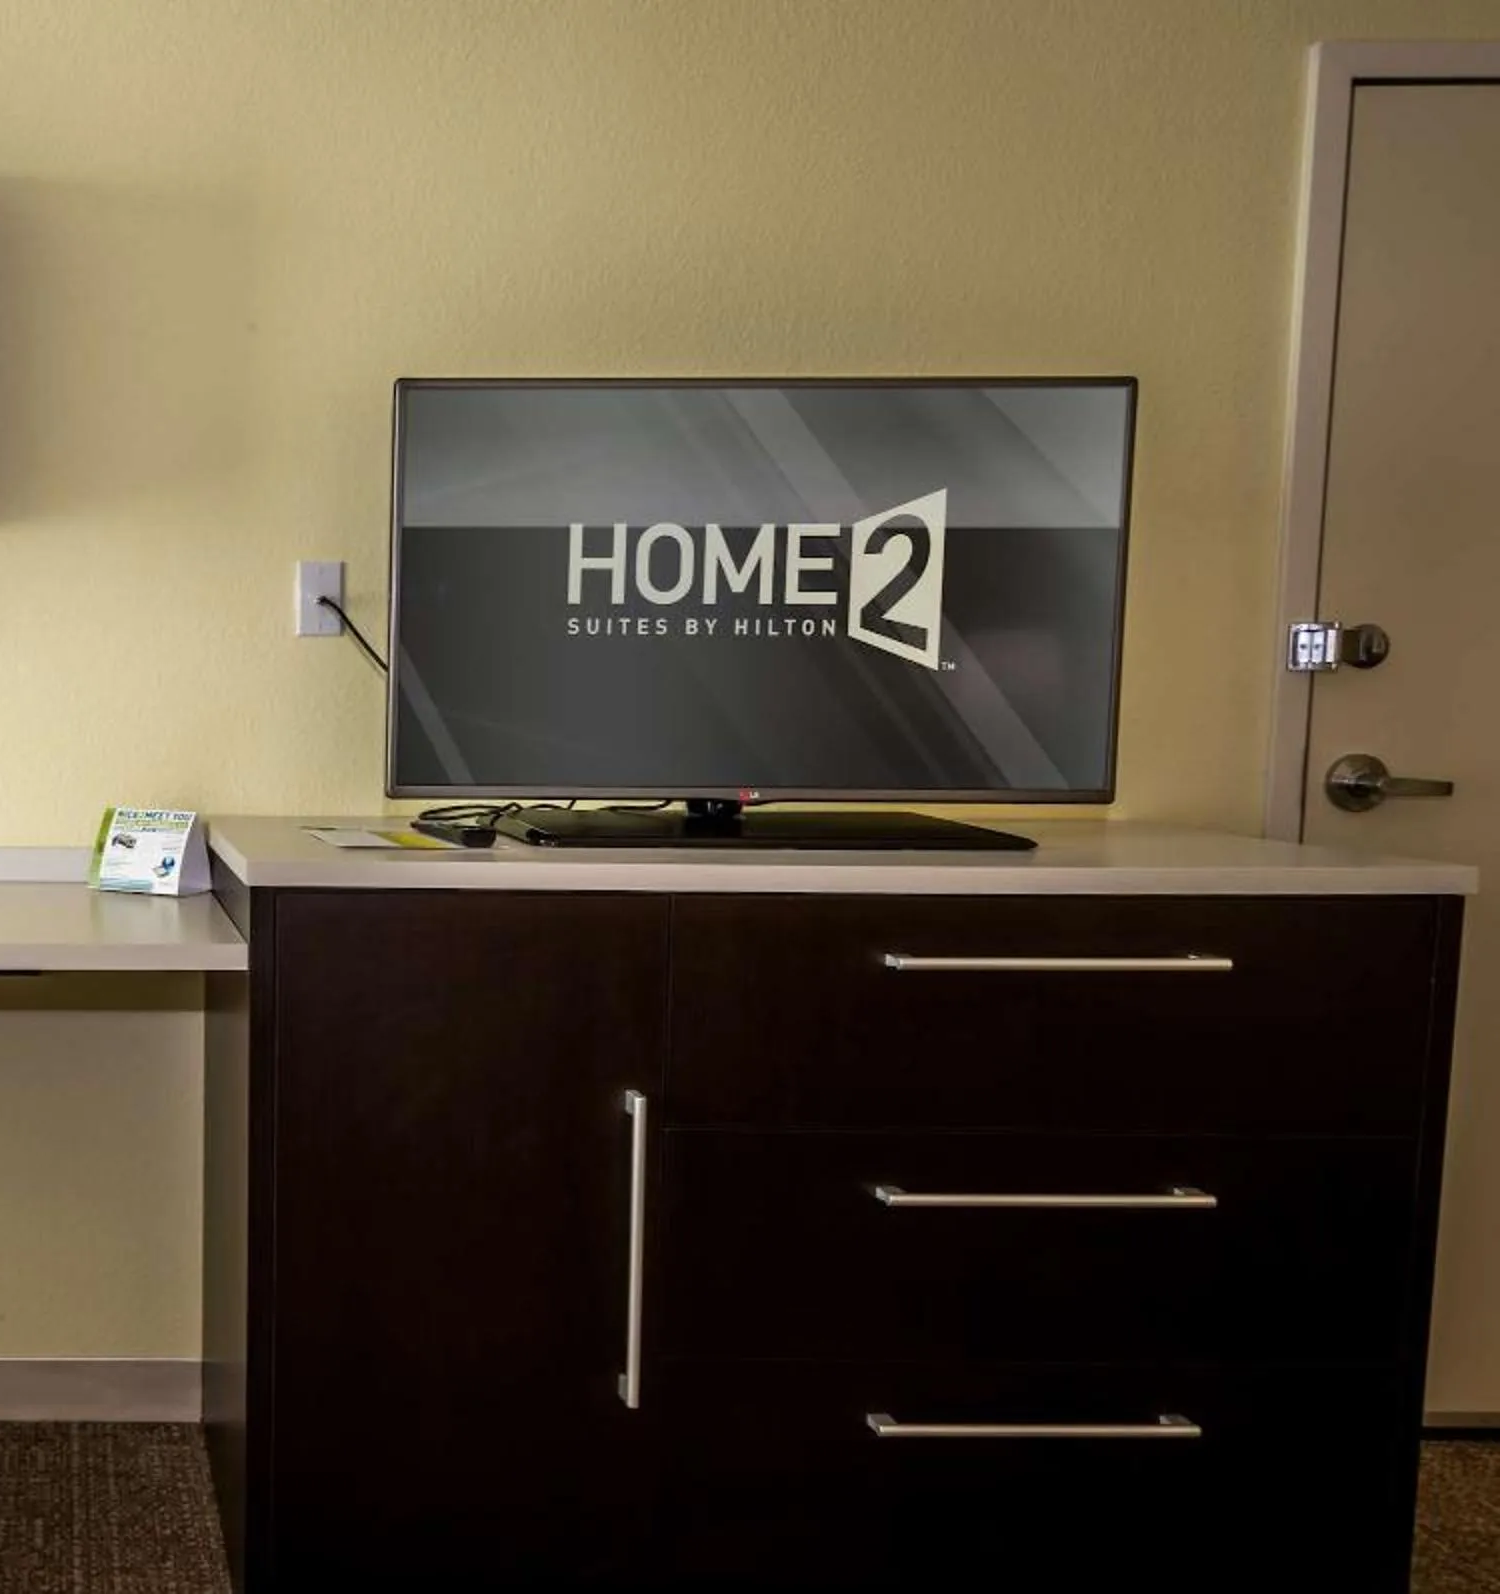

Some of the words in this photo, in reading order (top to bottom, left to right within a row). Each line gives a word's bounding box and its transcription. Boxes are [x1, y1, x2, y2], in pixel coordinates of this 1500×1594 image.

[567, 618, 668, 636] SUITES
[685, 618, 717, 636] BY
[734, 618, 836, 636] HILTON
